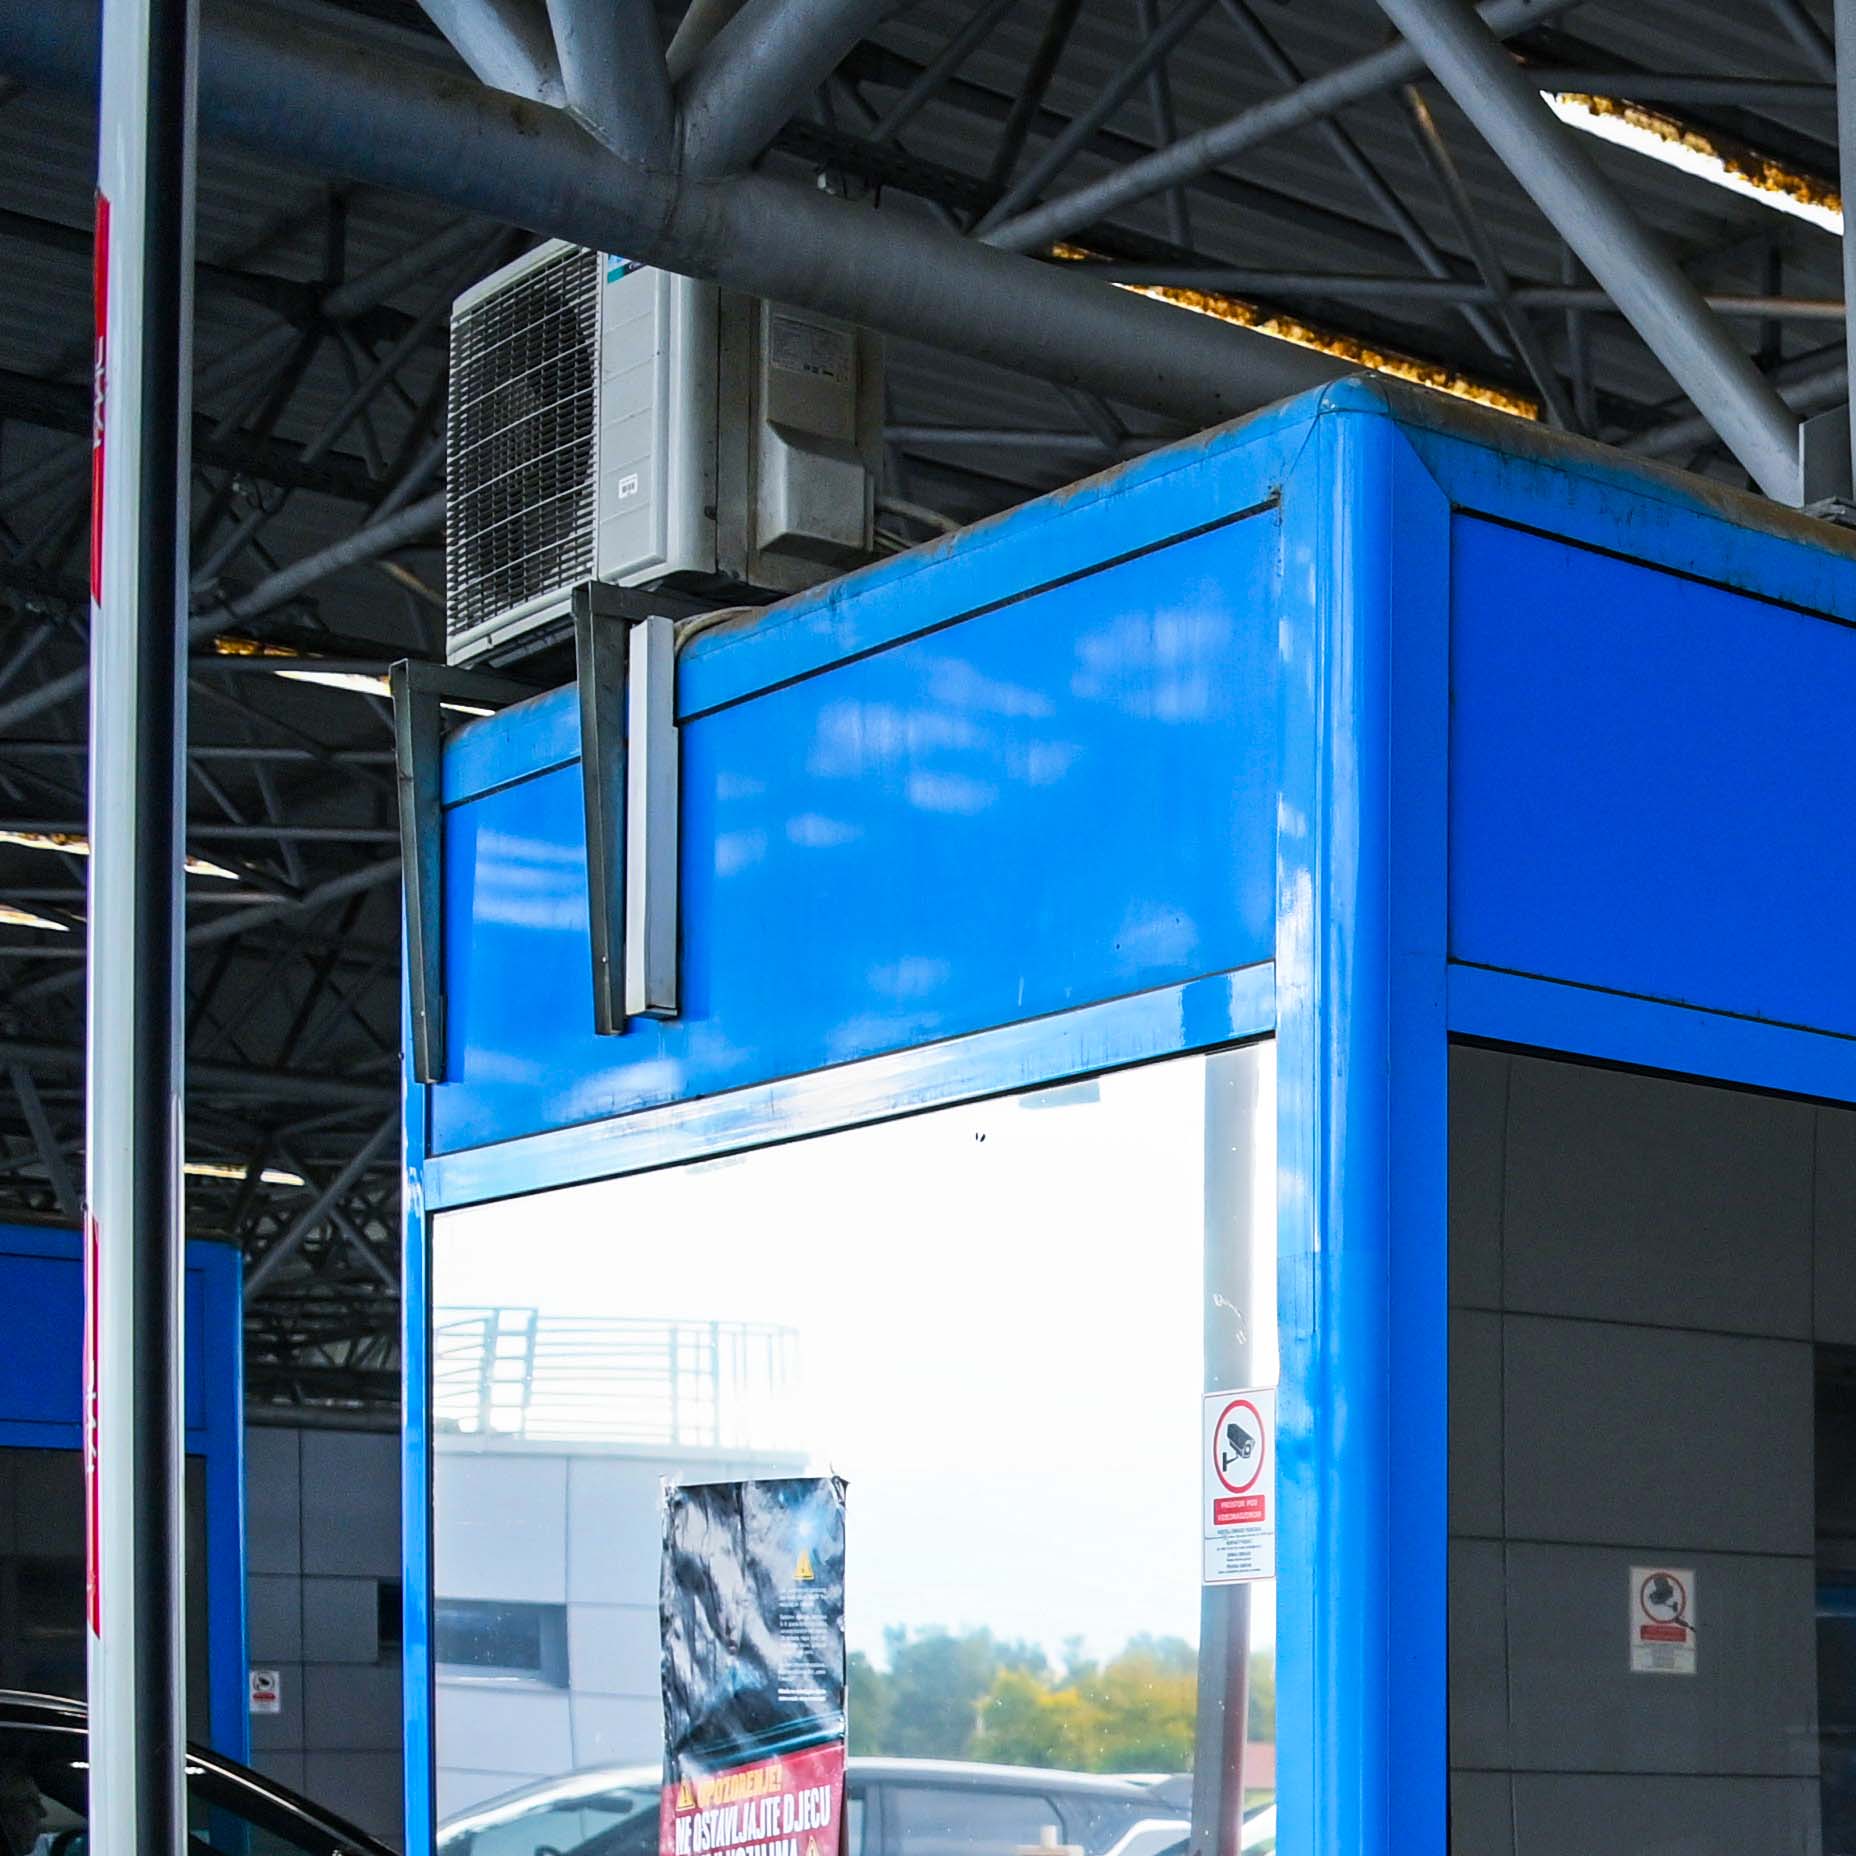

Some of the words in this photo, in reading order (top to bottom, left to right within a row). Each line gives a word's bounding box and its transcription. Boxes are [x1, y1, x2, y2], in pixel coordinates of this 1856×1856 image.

[675, 1815, 692, 1856] NE
[693, 1796, 781, 1851] OSTAVLJAJTE
[783, 1785, 831, 1834] DJECU
